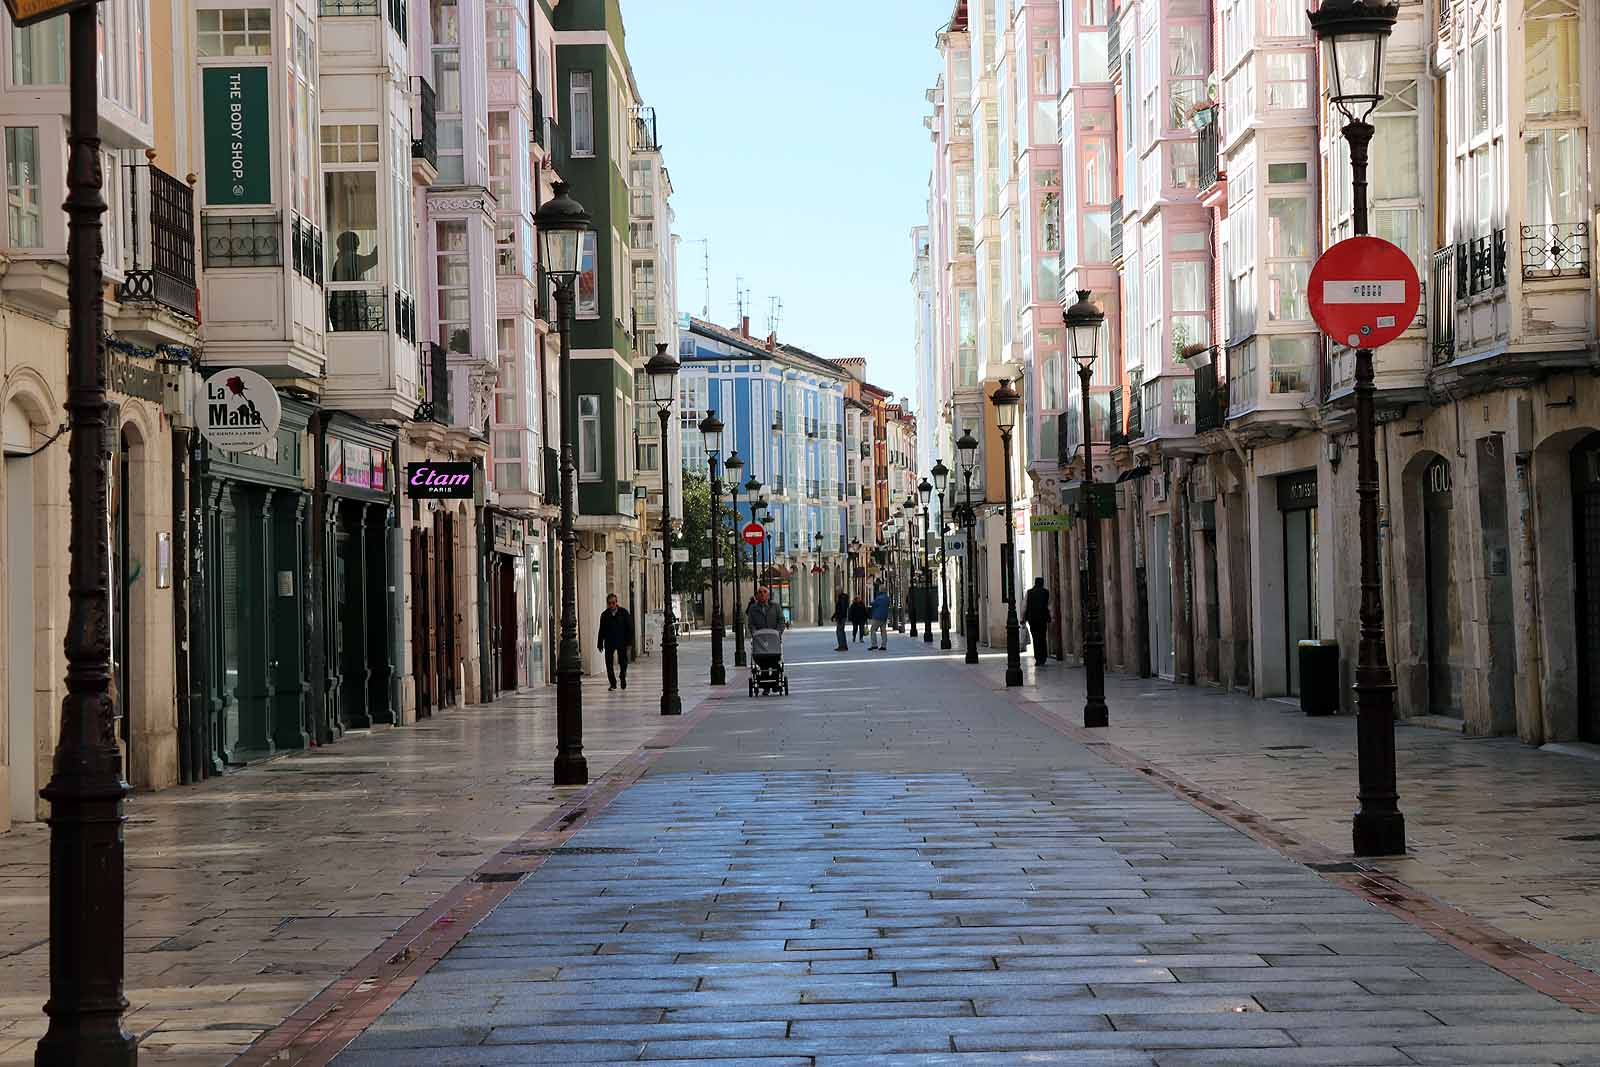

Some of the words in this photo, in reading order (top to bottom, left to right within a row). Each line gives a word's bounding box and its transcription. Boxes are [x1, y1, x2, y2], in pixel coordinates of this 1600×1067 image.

[229, 73, 241, 99] THE
[230, 103, 242, 139] BODY
[208, 382, 225, 400] La
[410, 467, 470, 486] Etam
